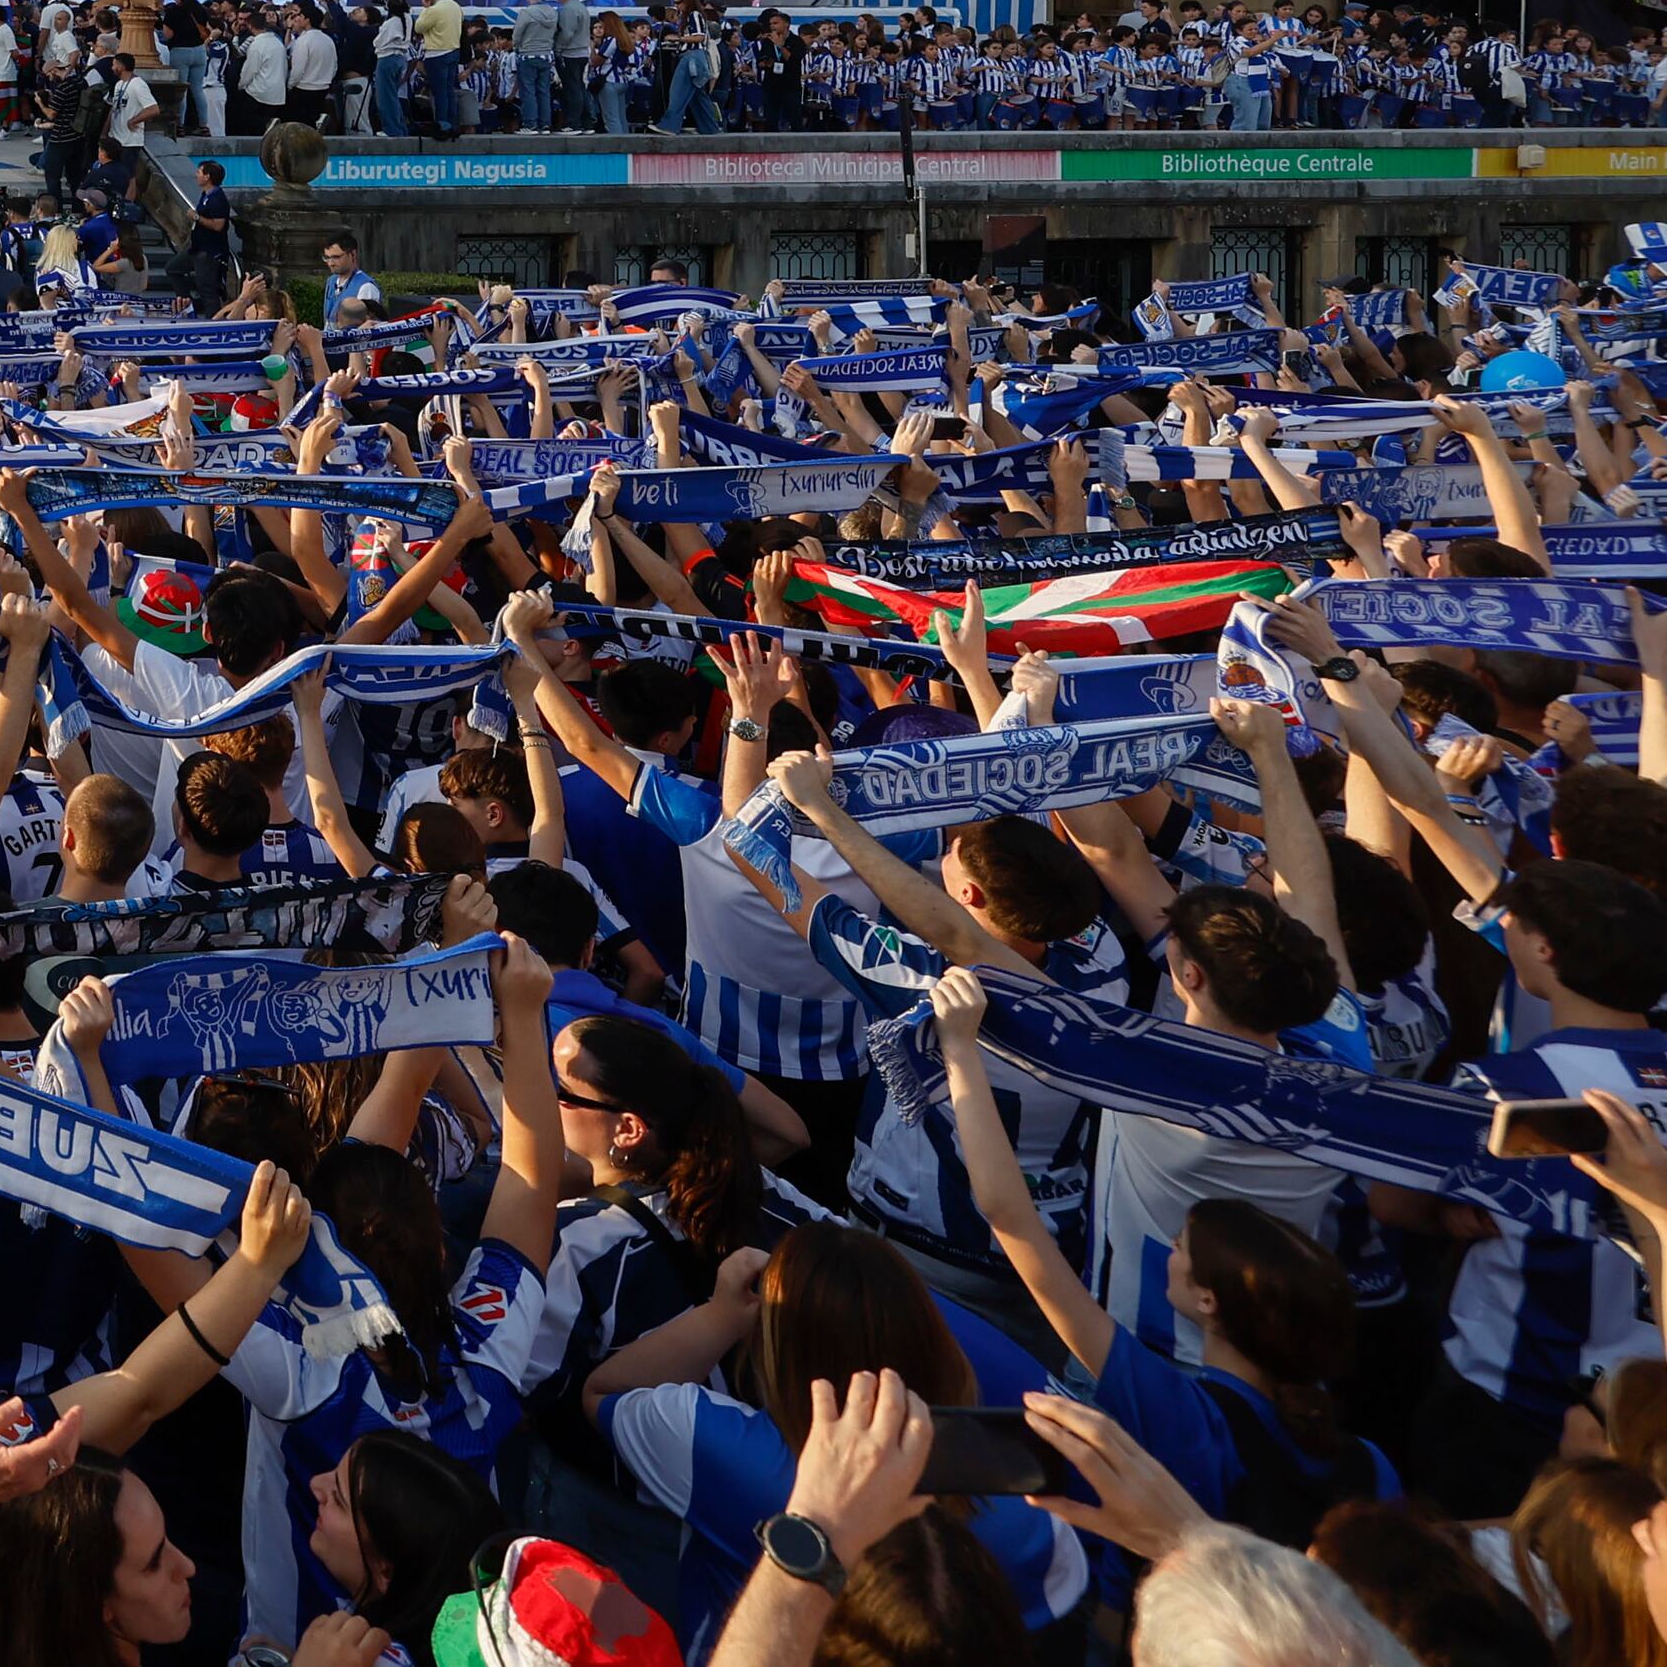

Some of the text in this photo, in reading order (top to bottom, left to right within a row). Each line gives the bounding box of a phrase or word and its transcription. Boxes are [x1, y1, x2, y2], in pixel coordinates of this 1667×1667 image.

[325, 158, 547, 188] Liburutegi Nagusia
[704, 152, 987, 177] Biblioteca Municipa Central
[1161, 149, 1375, 180] Bibliothèque Centrale
[1609, 152, 1657, 171] Main
